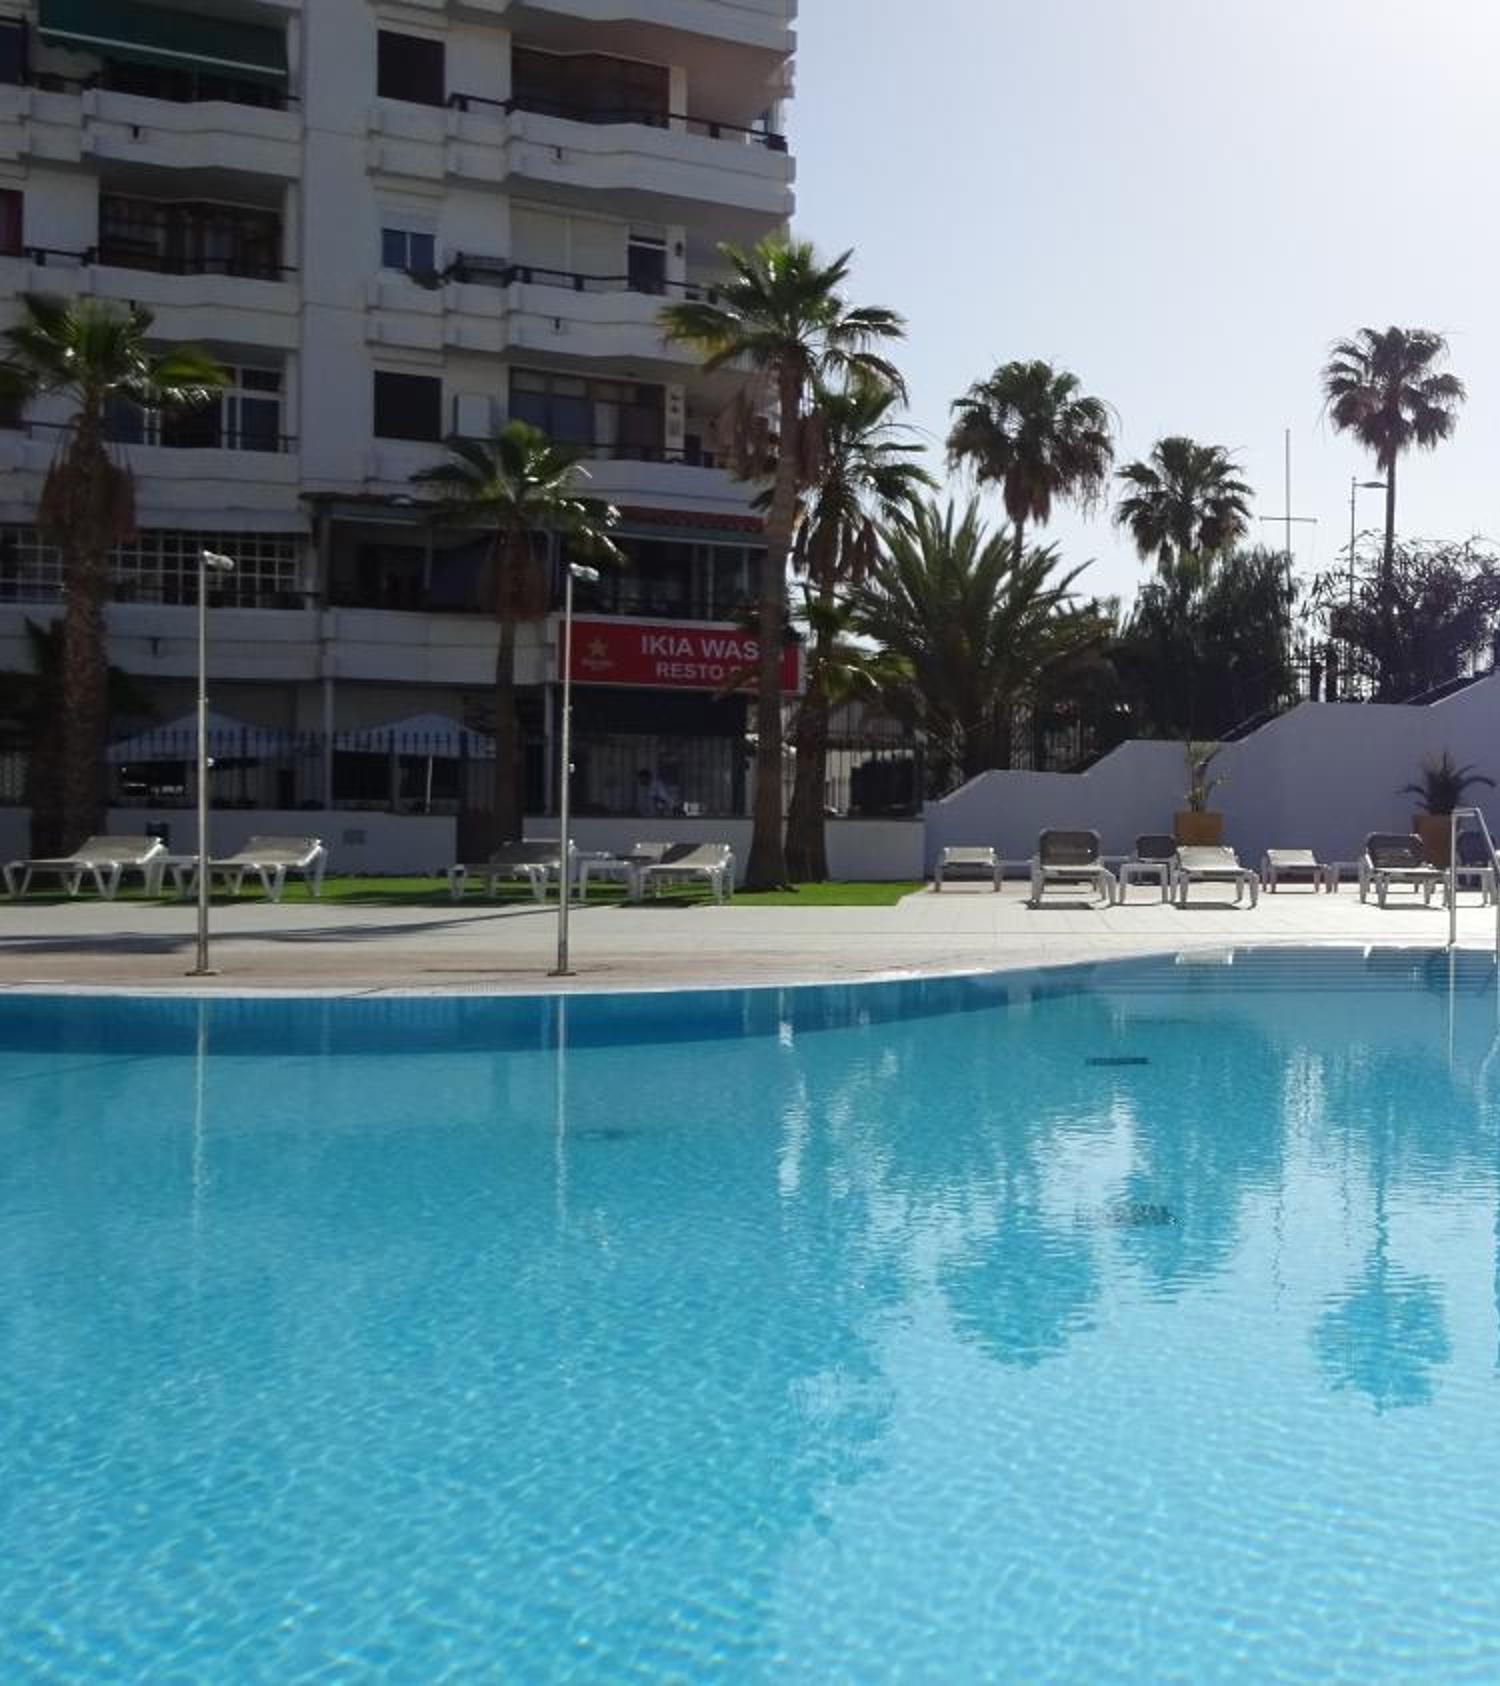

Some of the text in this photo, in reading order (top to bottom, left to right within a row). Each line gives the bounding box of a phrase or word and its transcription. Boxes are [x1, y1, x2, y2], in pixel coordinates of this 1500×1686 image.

[640, 634, 784, 662] IKIA WAS
[655, 660, 724, 680] RESTO
